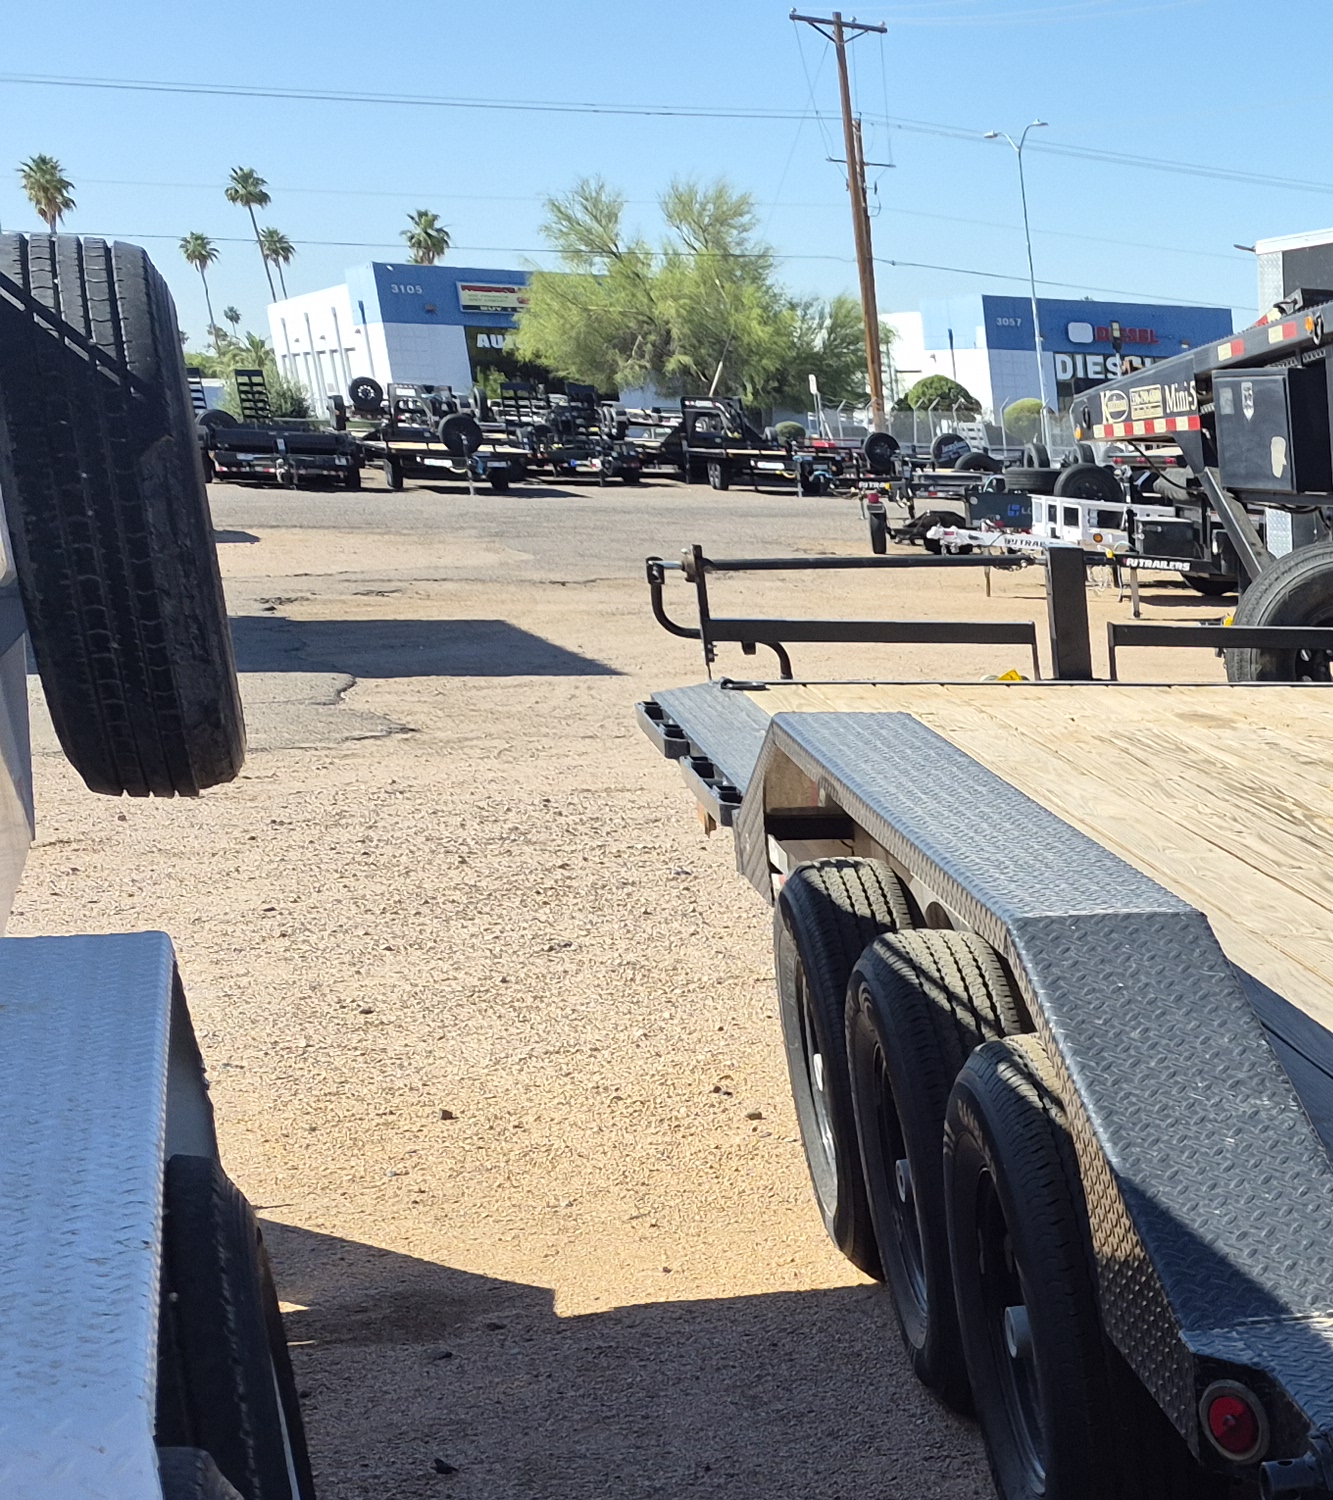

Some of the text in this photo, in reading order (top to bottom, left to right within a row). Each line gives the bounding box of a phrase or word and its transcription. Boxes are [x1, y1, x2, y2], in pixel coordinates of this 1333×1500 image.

[391, 284, 423, 294] 3105
[996, 317, 1022, 327] 3057
[1095, 326, 1160, 344] DESEL
[1164, 381, 1198, 413] Mini-5
[1126, 557, 1191, 572] PJ TRAILERS
